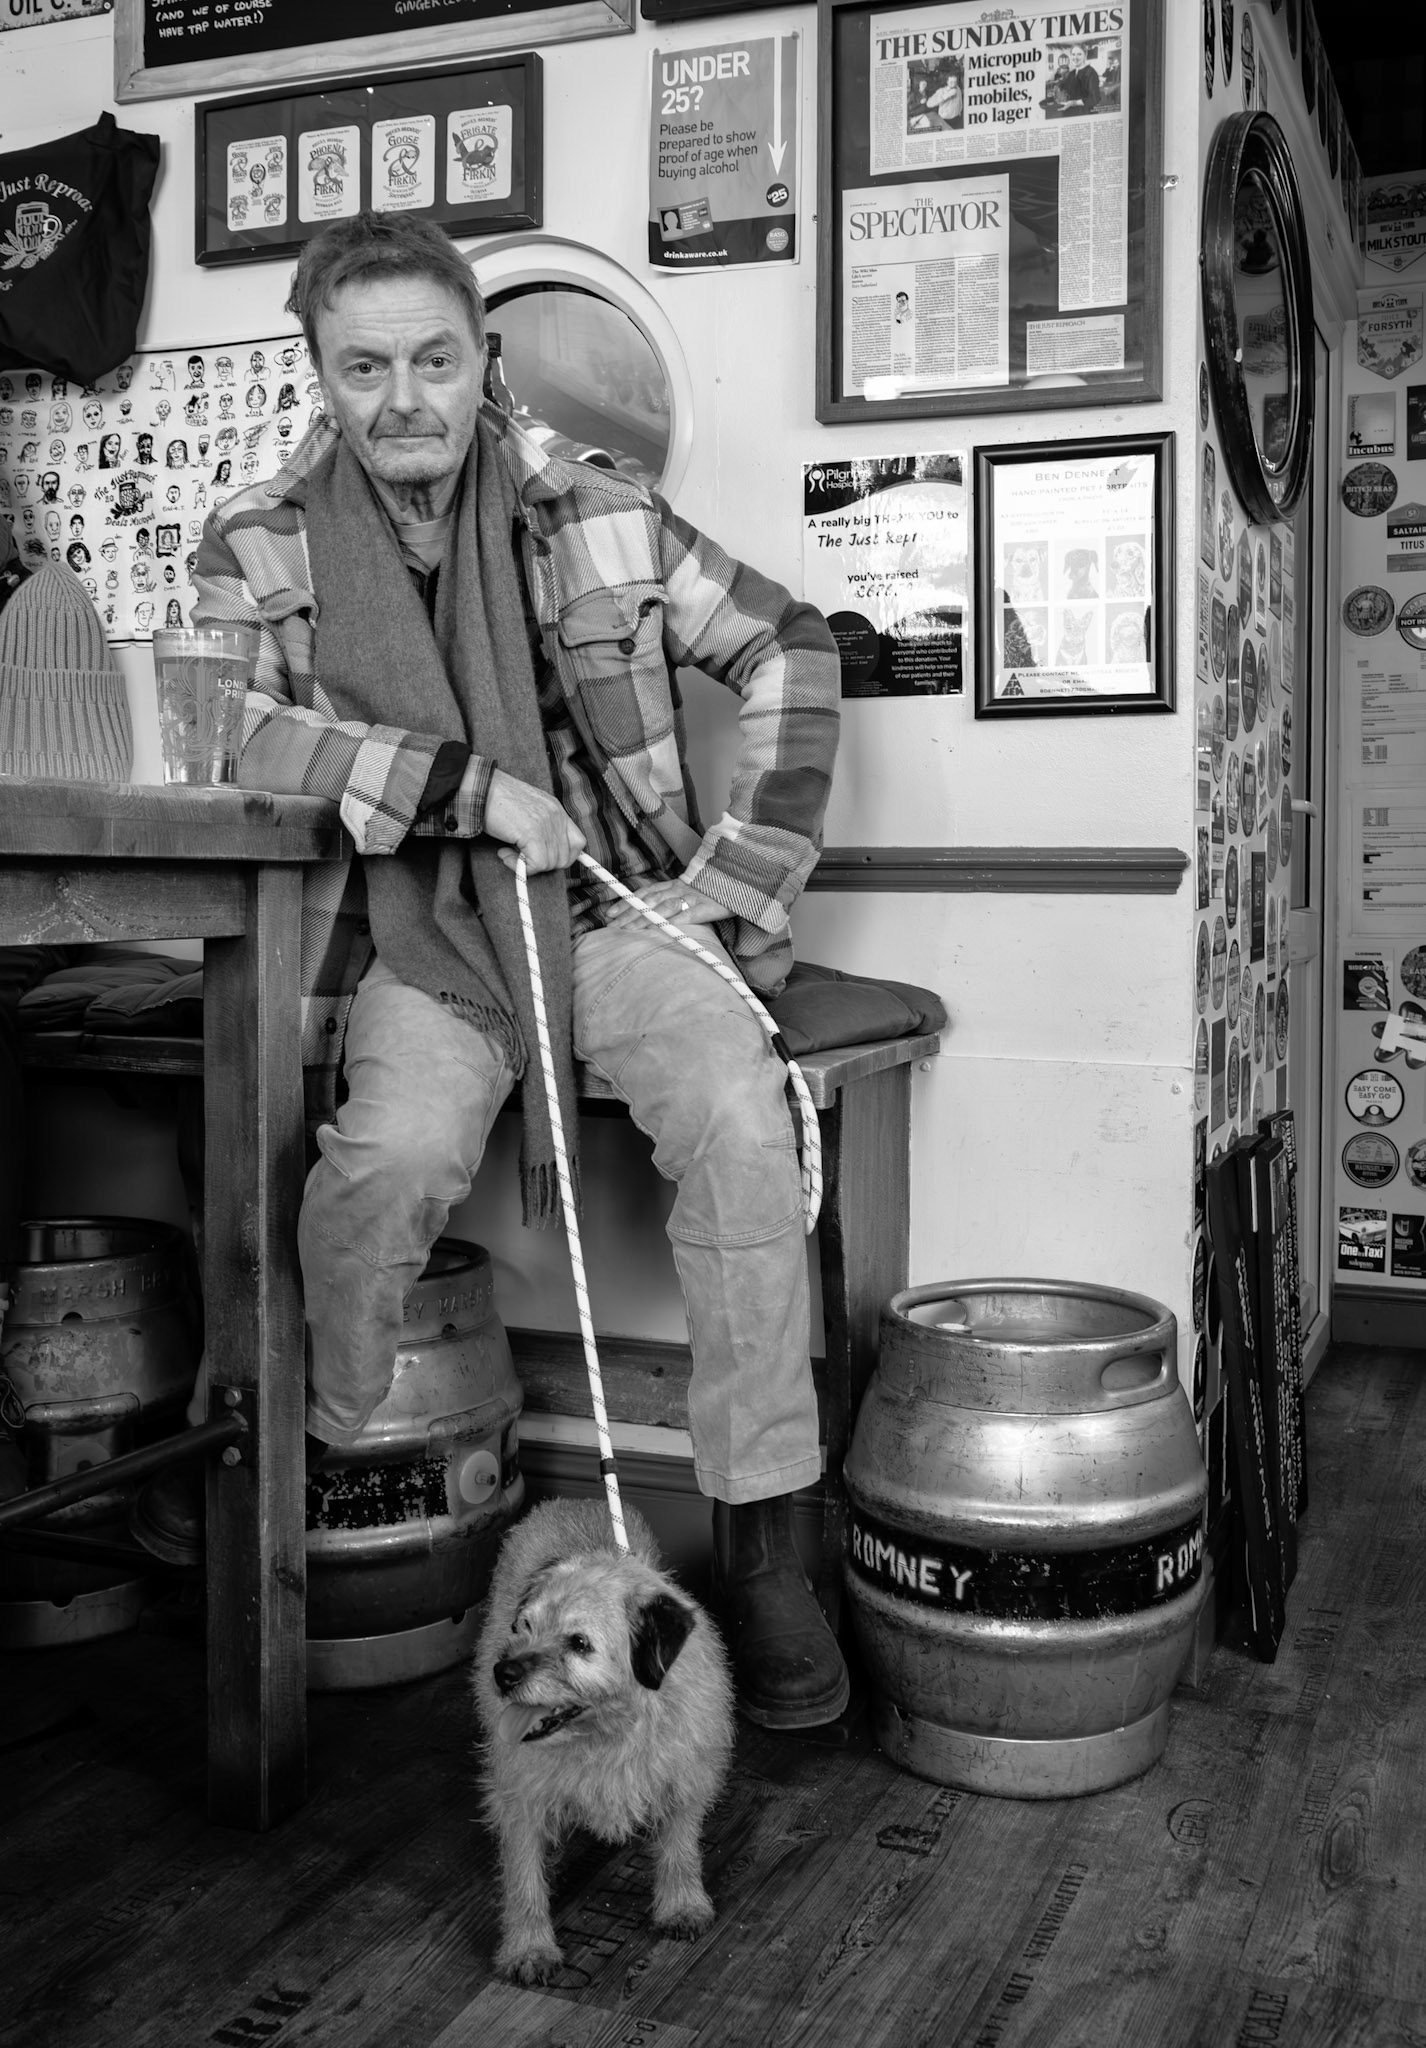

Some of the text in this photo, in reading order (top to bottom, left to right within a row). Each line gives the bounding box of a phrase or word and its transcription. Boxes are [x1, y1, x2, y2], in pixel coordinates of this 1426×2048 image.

[155, 10, 185, 23] (AND
[192, 6, 210, 16] WE
[215, 4, 231, 14] OF
[158, 10, 264, 38] HAVE TAP WATER!)
[876, 8, 1124, 61] THE SUNDAY TIMES
[968, 47, 1043, 70] Micropub
[662, 50, 751, 87] UNDER
[968, 69, 1035, 88] rules: no
[661, 85, 704, 115] 25?
[968, 87, 1033, 107] mobiles,
[968, 105, 1032, 125] no lager
[460, 124, 498, 139] FRIGATE
[660, 120, 714, 136] Please be
[388, 134, 420, 147] GOOSE
[659, 130, 757, 153] prepared to show
[309, 142, 347, 161] PHOENIX
[659, 144, 758, 165] proof of age when
[388, 171, 418, 187] FIRKIN
[463, 163, 496, 182] FIRKIN
[658, 160, 740, 180] buying alcohol
[313, 179, 344, 197] FIRKIN
[915, 197, 934, 207] THE
[850, 200, 1002, 241] SPECTATOR
[1367, 237, 1393, 251] MILK
[663, 249, 729, 260] drinkaware.co.uk
[1368, 320, 1413, 332] FORSYTH
[1348, 444, 1394, 456] Incubus
[808, 519, 817, 528] A
[821, 517, 850, 528] really
[853, 515, 871, 526] big
[947, 510, 959, 519] to
[818, 533, 879, 548] The Just
[1400, 540, 1425, 550] TITUS
[885, 569, 919, 581] raised
[911, 672, 931, 680] patients
[925, 664, 936, 672] help
[944, 664, 958, 672] many
[1353, 1085, 1397, 1094] EASY COME
[1358, 1092, 1391, 1100] EASY GO
[1340, 1243, 1384, 1259] One Taxi
[853, 1522, 973, 1601] ROMNEY
